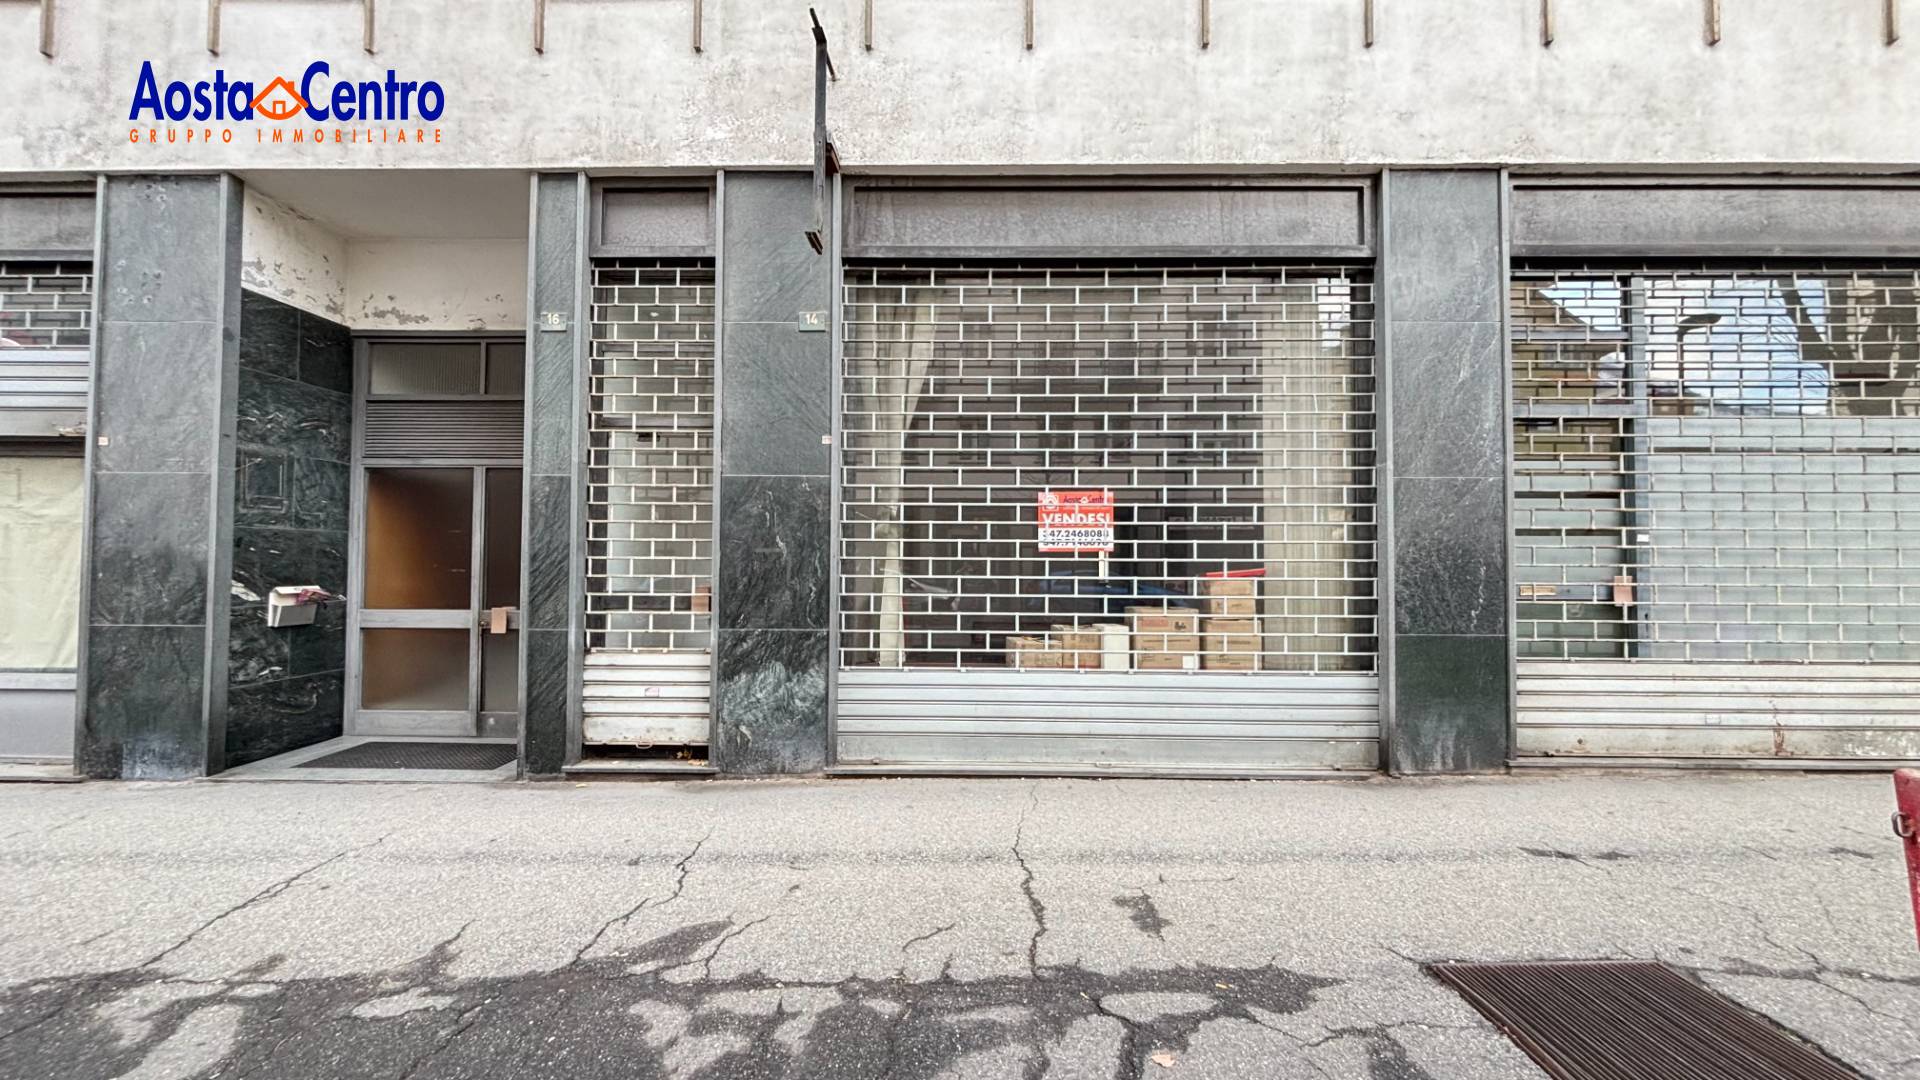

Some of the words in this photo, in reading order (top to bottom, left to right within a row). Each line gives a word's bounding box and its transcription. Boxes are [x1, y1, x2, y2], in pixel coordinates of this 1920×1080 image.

[547, 312, 560, 325] 16
[805, 312, 818, 325] 14
[1042, 512, 1111, 524] VENDESI
